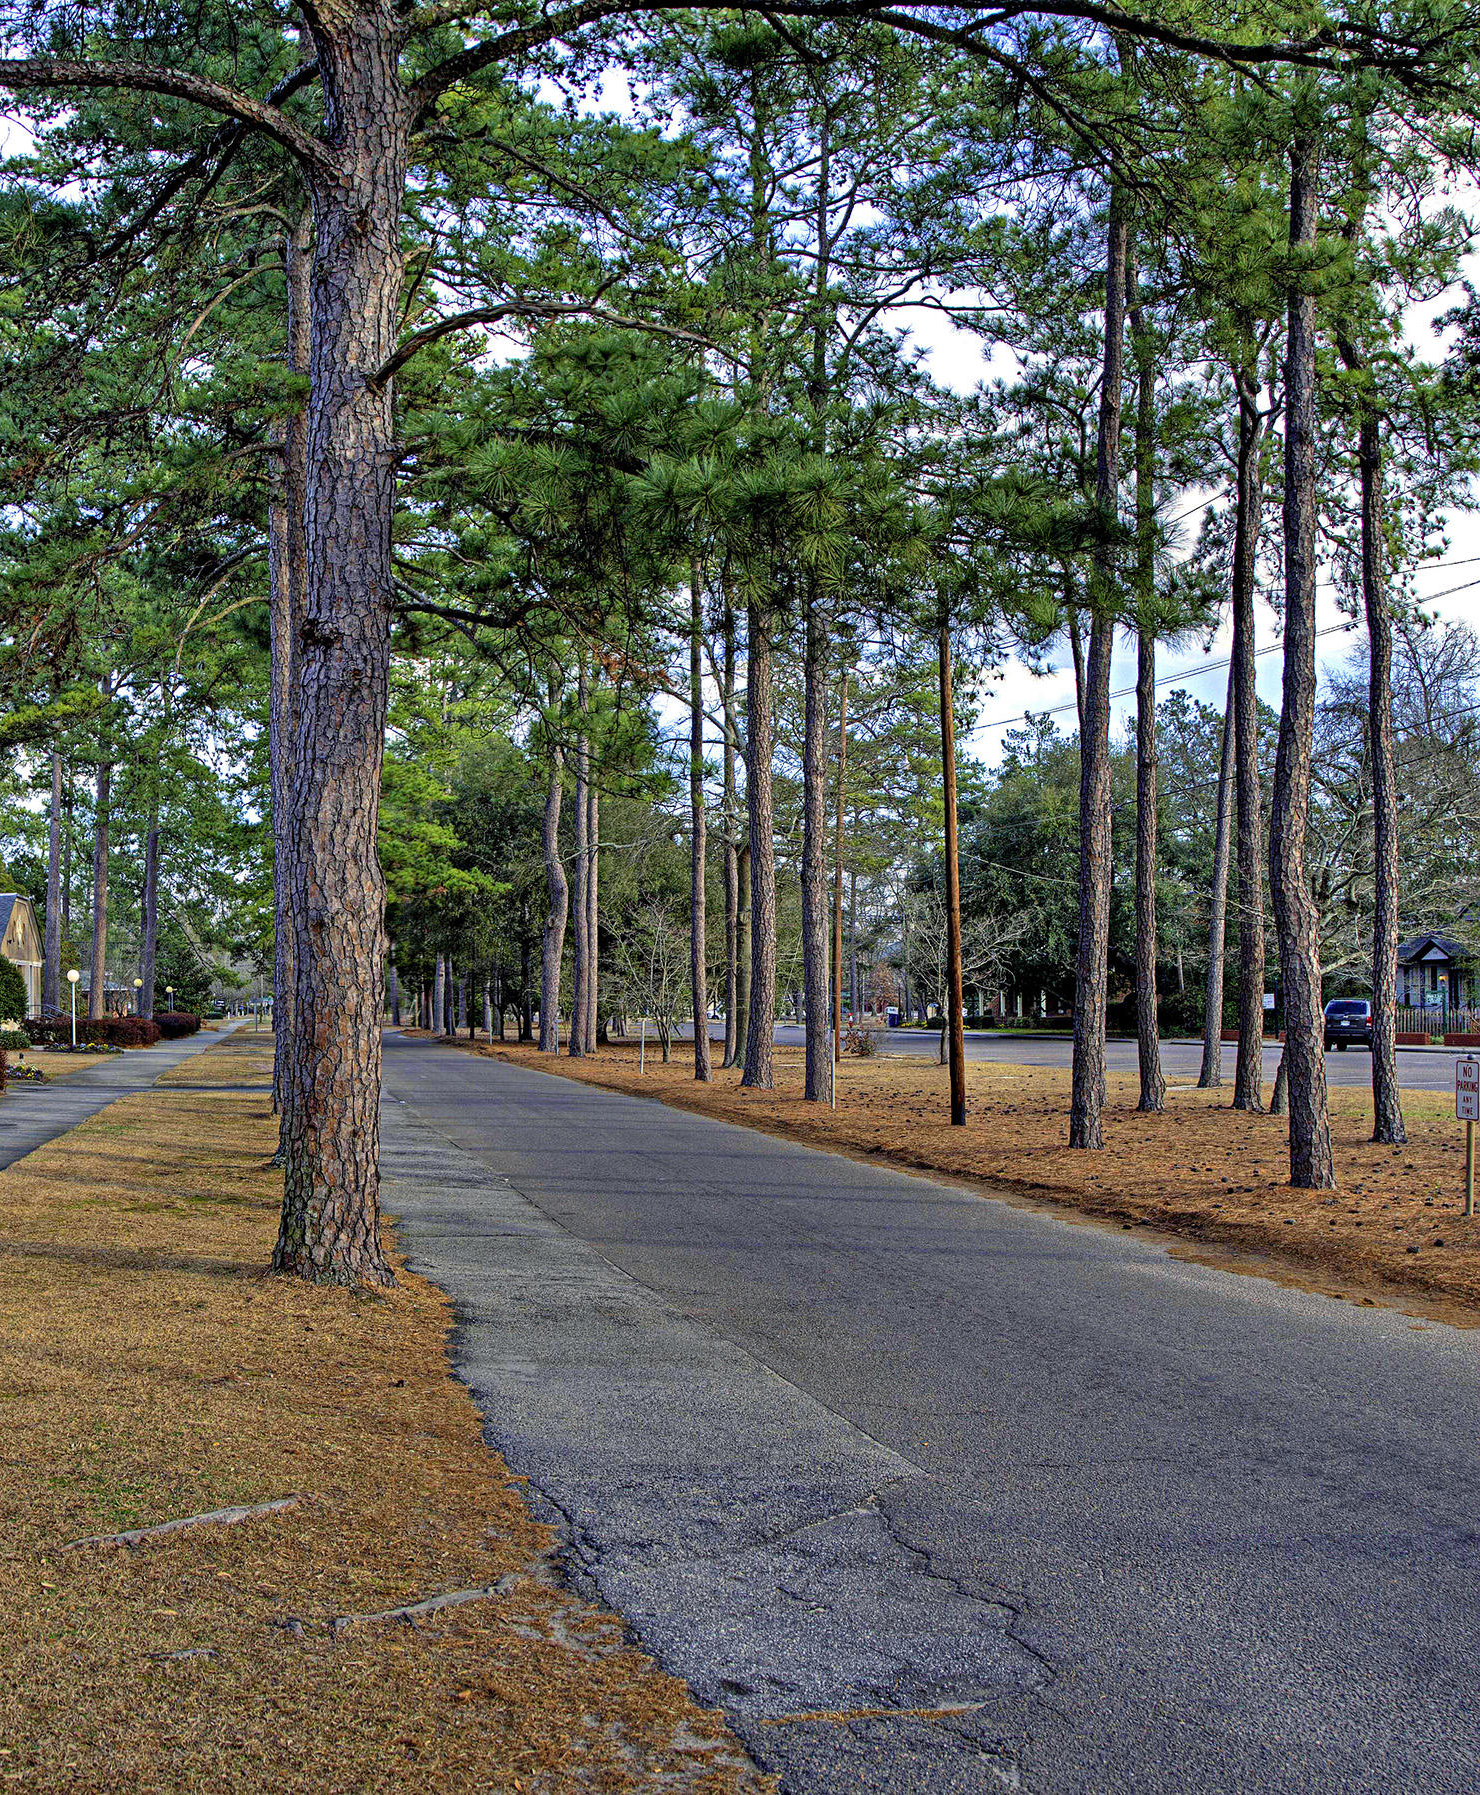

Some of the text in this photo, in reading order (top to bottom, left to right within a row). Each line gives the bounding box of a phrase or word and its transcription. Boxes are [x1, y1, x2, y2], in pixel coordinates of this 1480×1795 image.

[1463, 1066, 1472, 1078] NO
[1457, 1080, 1478, 1092] PARKING
[1463, 1096, 1472, 1104] ANY
[1462, 1106, 1473, 1115] TIME
